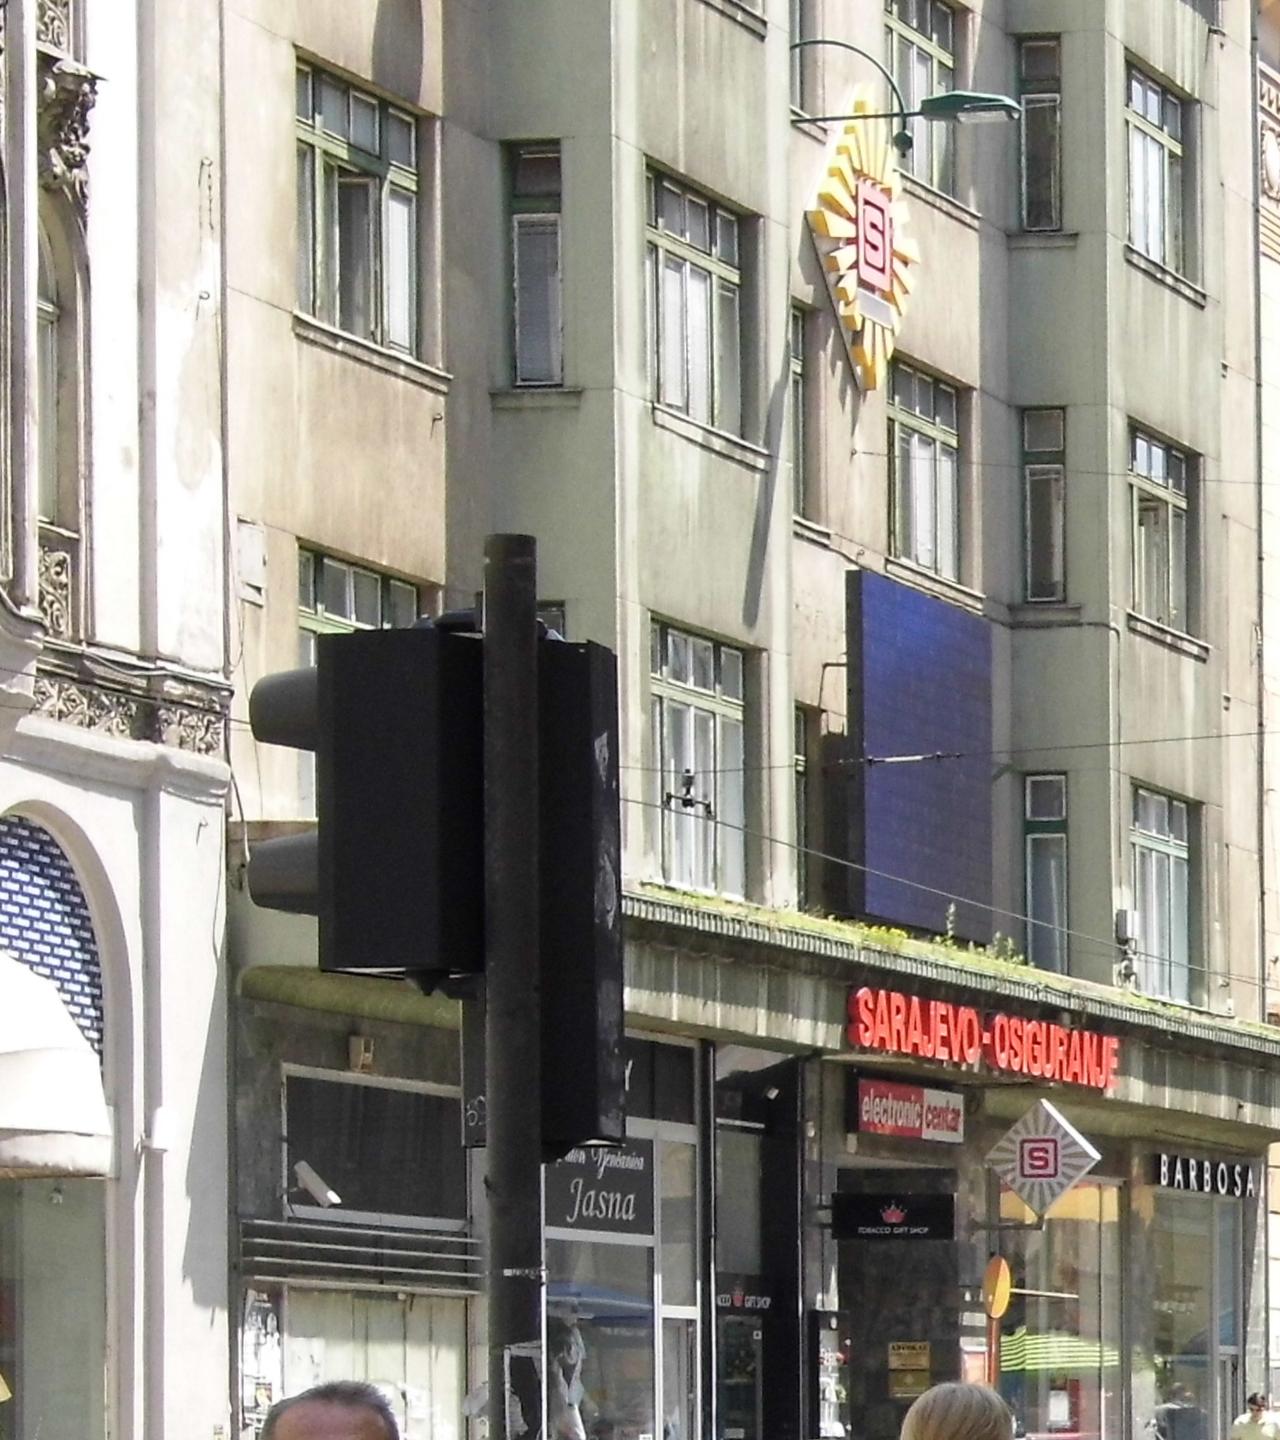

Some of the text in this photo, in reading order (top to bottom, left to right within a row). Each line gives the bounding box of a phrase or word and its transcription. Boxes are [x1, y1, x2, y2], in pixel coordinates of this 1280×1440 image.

[861, 1087, 923, 1128] electronic
[1160, 1153, 1255, 1198] BARBOSA
[566, 1178, 636, 1223] Jasna
